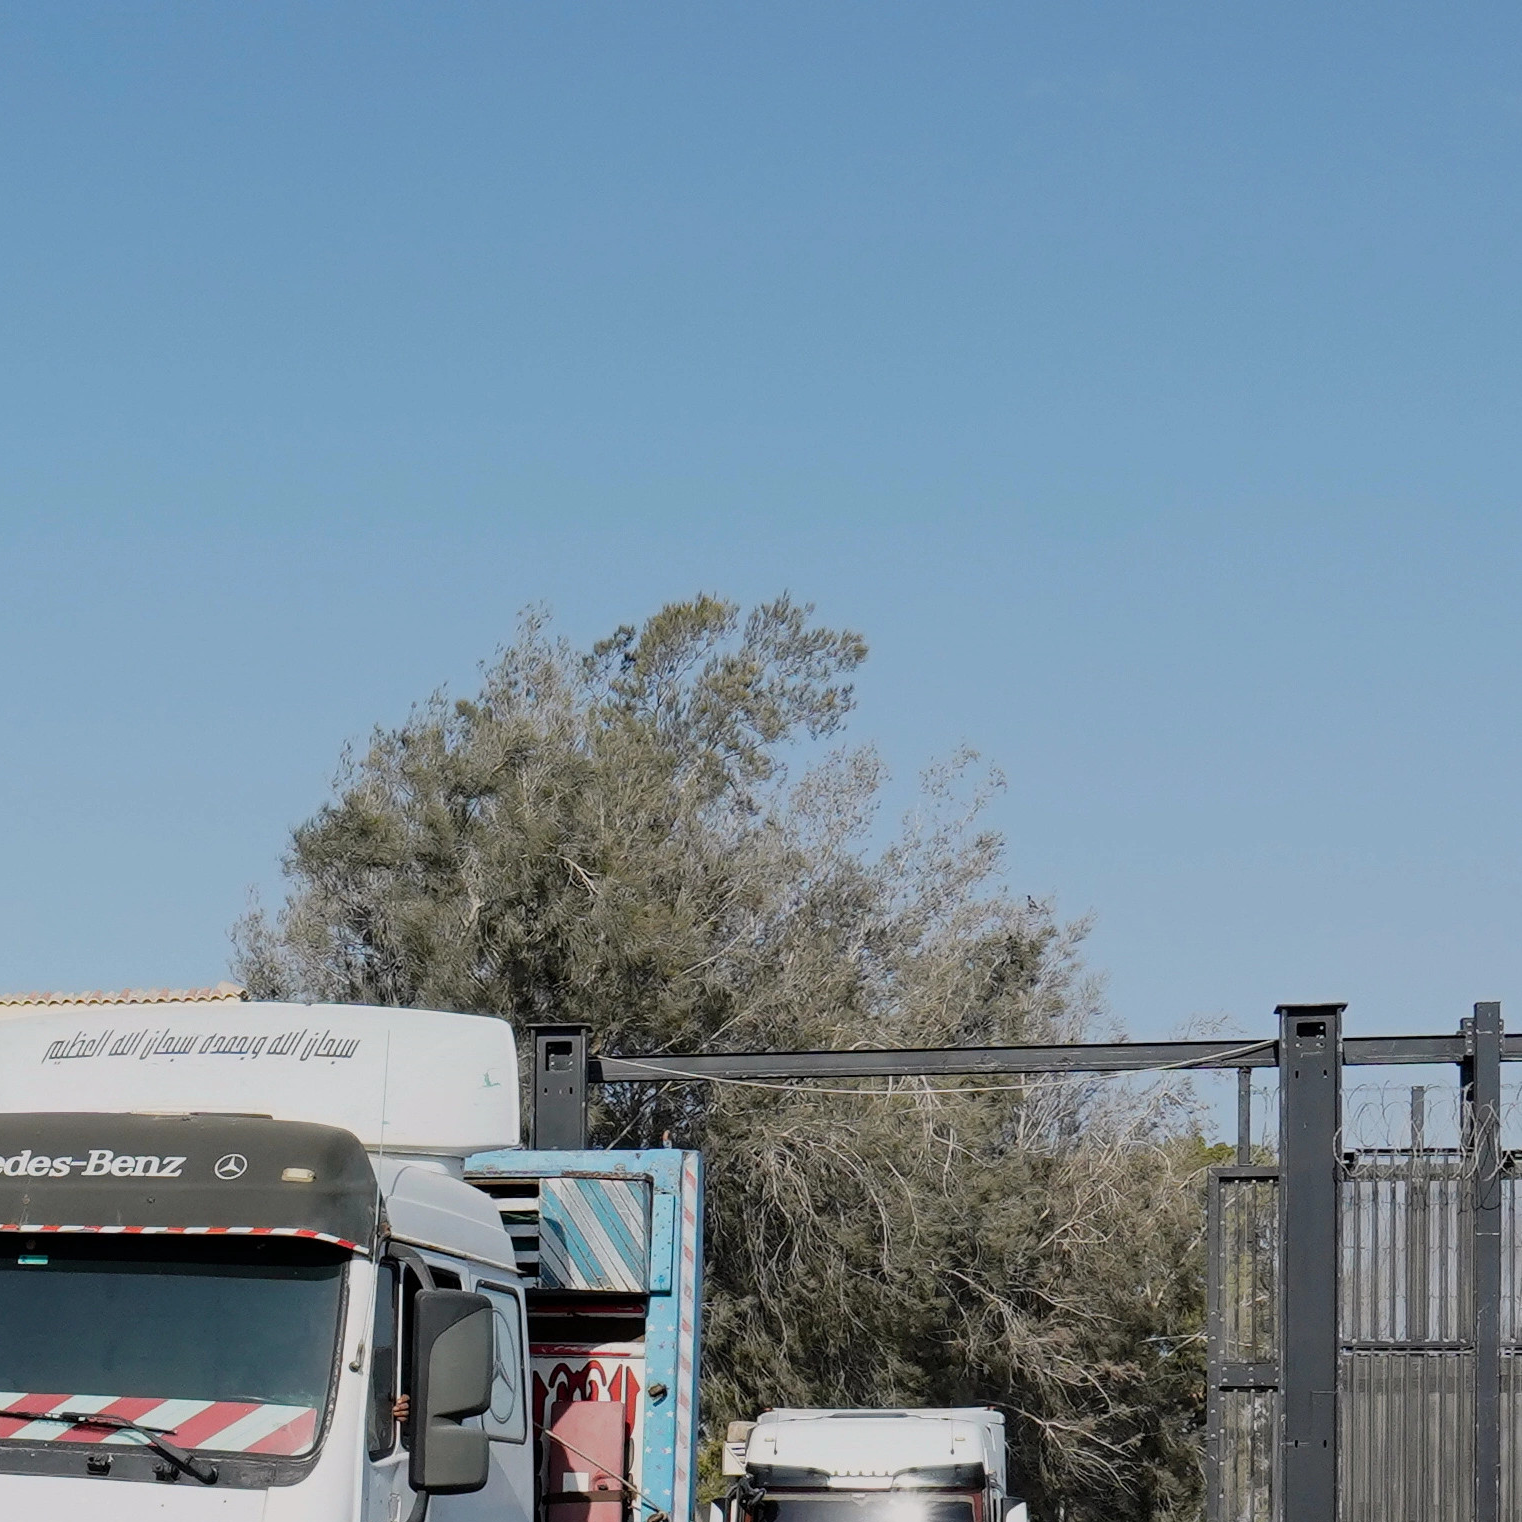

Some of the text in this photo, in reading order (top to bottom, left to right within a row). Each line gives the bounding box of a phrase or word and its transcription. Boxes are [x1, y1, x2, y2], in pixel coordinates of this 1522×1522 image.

[42, 1028, 361, 1065] سبحان الله وبحمده سبحان الله العظيم
